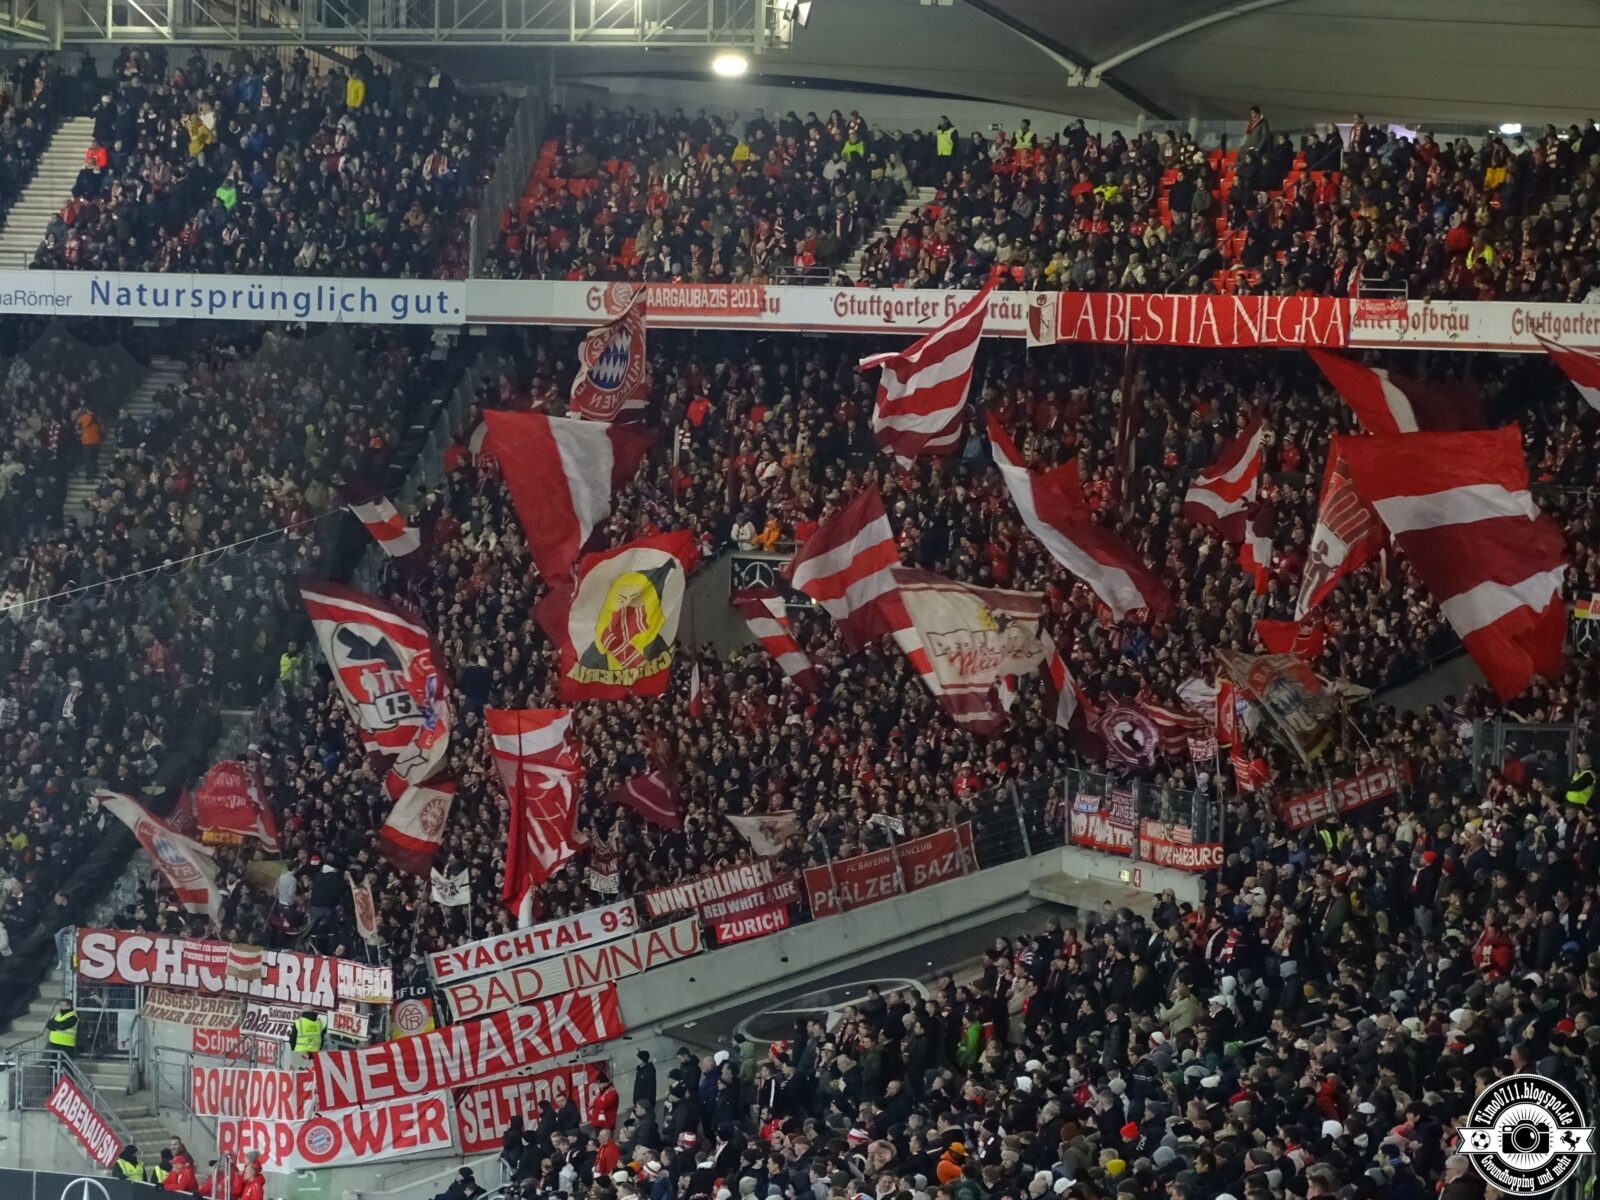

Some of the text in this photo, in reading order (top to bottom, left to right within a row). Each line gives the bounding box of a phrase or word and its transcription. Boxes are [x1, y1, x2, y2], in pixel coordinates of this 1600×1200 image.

[90, 280, 460, 319] Natursprünglich gut.
[646, 287, 729, 309] AARGAUBAZIS
[731, 288, 759, 309] 2011
[833, 291, 938, 321] Stuttgarter
[1056, 292, 1346, 346] LA BESTIA NEGRA
[385, 694, 412, 716] 15
[858, 854, 891, 872] BAYERN
[649, 860, 775, 917] WINTERLINGEN
[703, 902, 727, 920] RED
[727, 891, 766, 914] WHITE
[772, 881, 797, 901] LIFE
[434, 905, 636, 978] EYACHTAL 93
[449, 918, 700, 1018] BAD IMNAU
[144, 1004, 181, 1023] IMMER
[184, 1011, 207, 1026] BEI
[208, 1013, 235, 1028] UNS
[149, 988, 241, 1016] AUSGESPERRTE
[319, 983, 613, 1108] NEUMARKT
[192, 1067, 316, 1120] ROHRDORF
